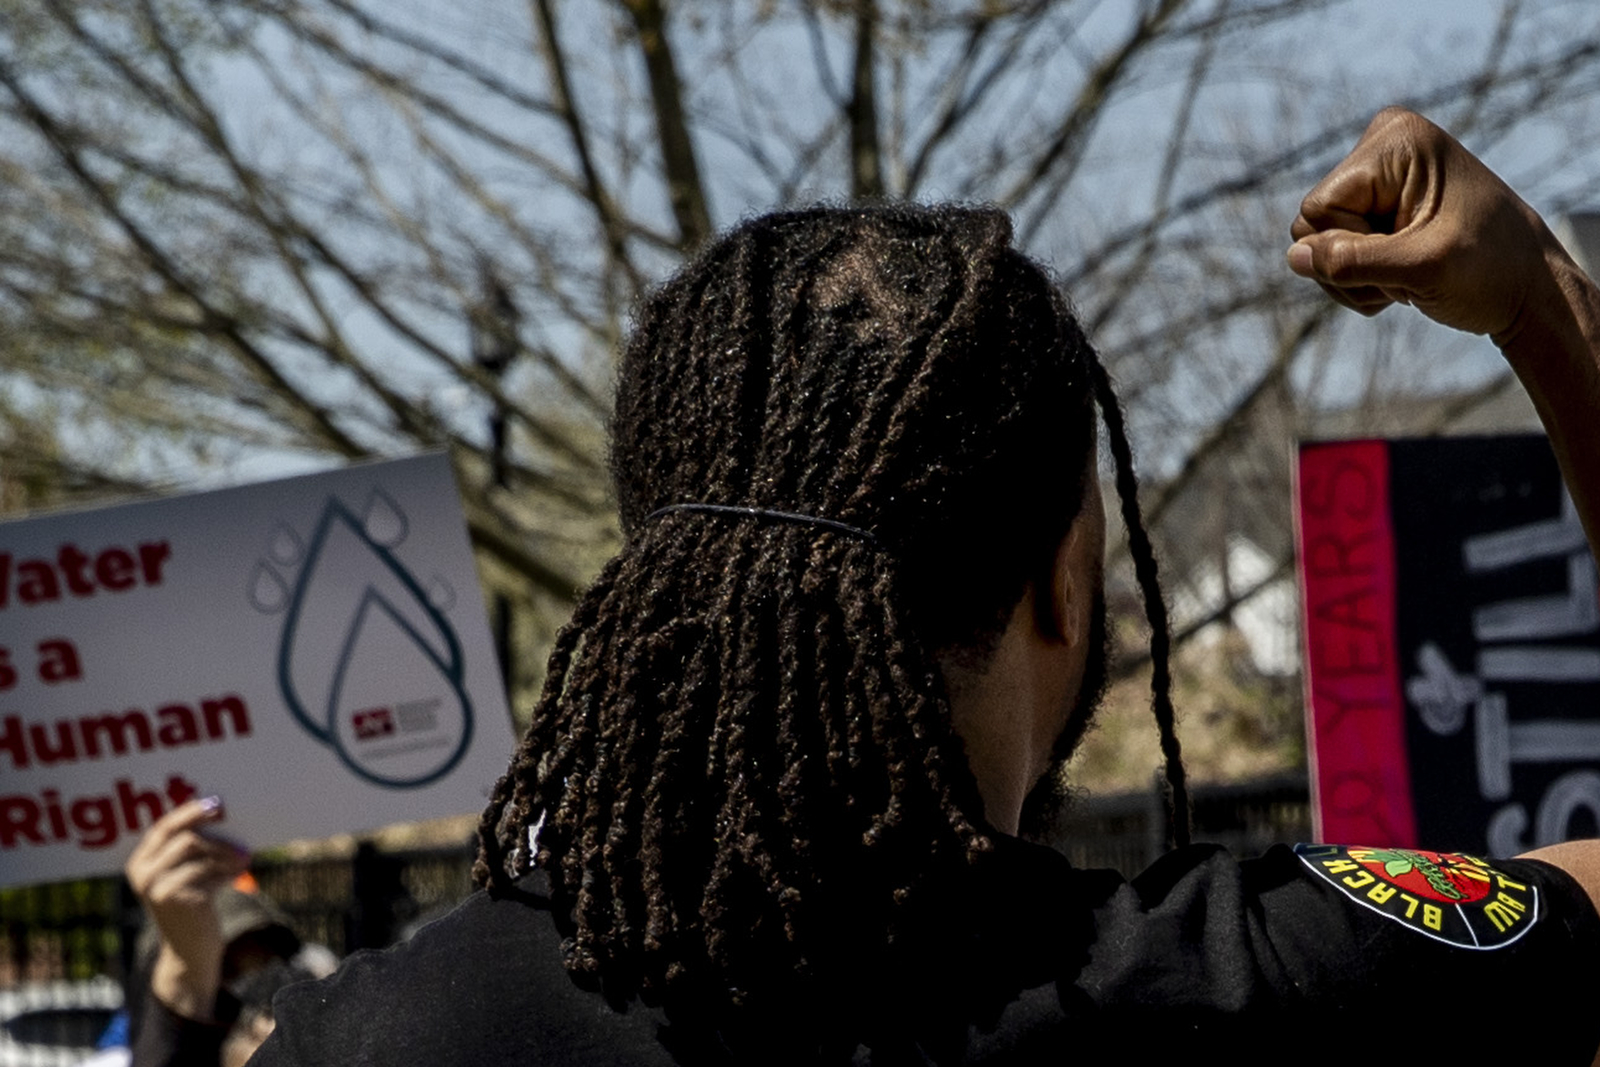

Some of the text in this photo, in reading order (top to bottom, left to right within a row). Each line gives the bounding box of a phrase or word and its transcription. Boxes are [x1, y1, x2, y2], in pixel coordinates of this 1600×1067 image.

[0, 539, 172, 607] ater
[37, 638, 82, 684] a
[1322, 858, 1442, 931] BLACK
